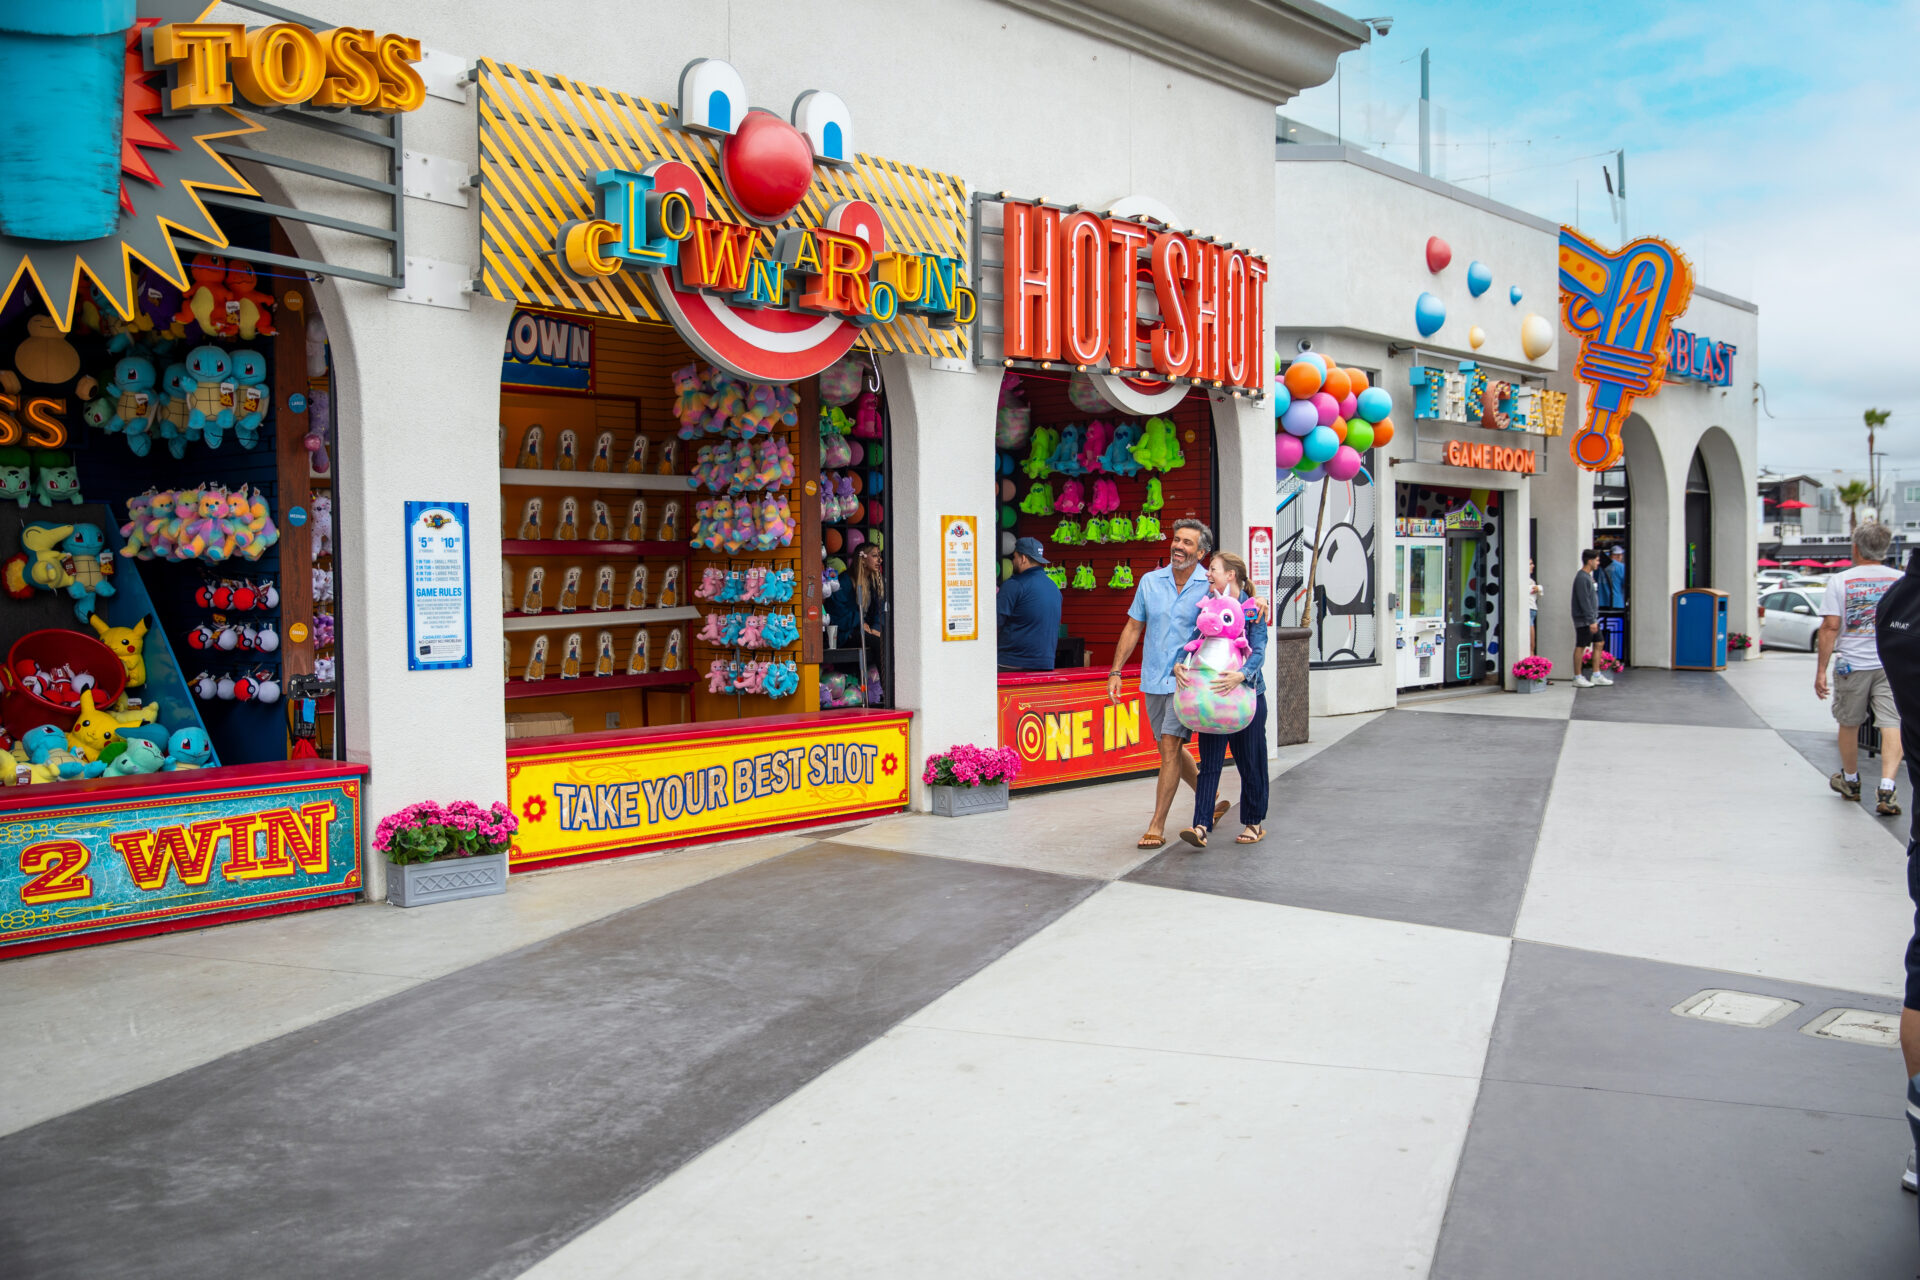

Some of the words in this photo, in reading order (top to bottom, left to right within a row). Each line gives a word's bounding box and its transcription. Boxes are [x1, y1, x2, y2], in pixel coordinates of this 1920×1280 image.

[153, 22, 426, 113] TOSS
[564, 168, 788, 307] CLOWN
[783, 227, 977, 328] AROUND
[1003, 201, 1146, 368] HOT
[1151, 232, 1268, 389] SHOT
[1445, 440, 1491, 469] GAME
[1493, 445, 1536, 474] ROOM
[416, 588, 437, 597] GAME
[439, 587, 462, 596] RULES
[1848, 585, 1888, 600] VINTAG
[1890, 621, 1910, 630] ARIAT
[1016, 710, 1093, 762] ONE
[1103, 699, 1140, 751] IN
[554, 781, 640, 831] TAKE
[641, 765, 729, 824] YOUR
[733, 746, 806, 803] BEST
[806, 741, 879, 789] SHOT
[20, 839, 94, 906] 2
[112, 800, 336, 890] WIN
